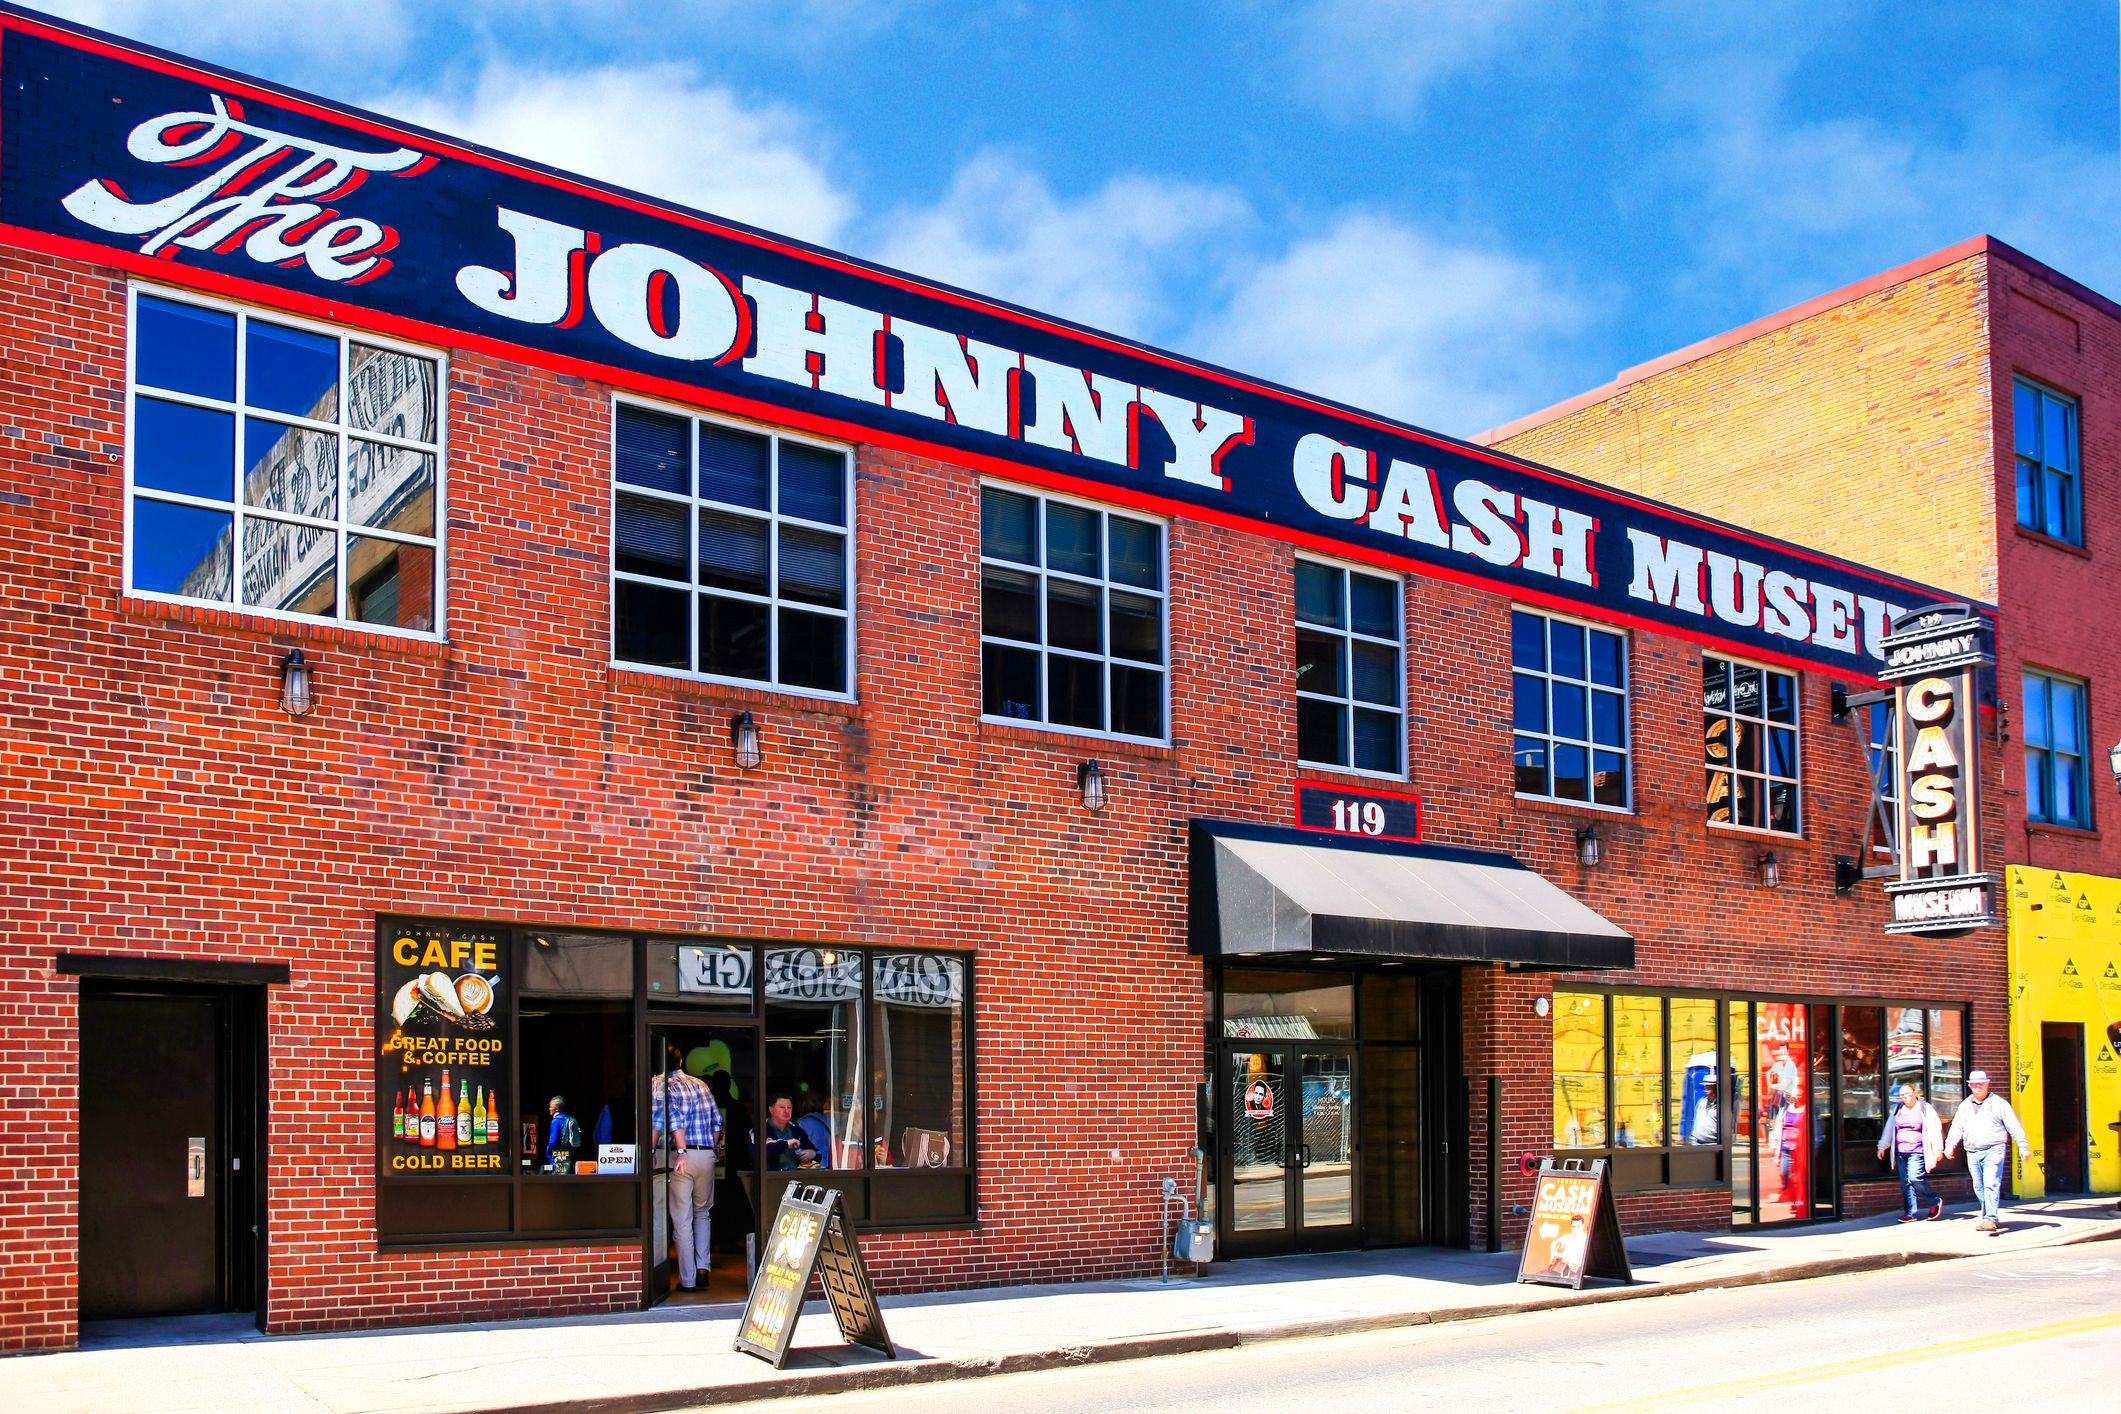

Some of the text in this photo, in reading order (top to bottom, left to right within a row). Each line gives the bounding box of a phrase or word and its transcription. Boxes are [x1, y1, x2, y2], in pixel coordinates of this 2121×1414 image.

[61, 94, 1911, 662] The JOHNNY CASH MUSEU
[1888, 634, 1974, 666] JOHNNY
[1906, 677, 1958, 867] CASH
[1332, 800, 1385, 836] 119
[1895, 887, 1983, 921] MUSEUM
[397, 930, 495, 941] JOHNNY CASH
[393, 938, 497, 970] CAFE
[1757, 1016, 1804, 1041] CASH
[390, 1036, 502, 1052] GREAT FOOD
[403, 1050, 490, 1065] & COFFEE
[392, 1155, 501, 1169] COLD BEER
[600, 1156, 633, 1164] OPEN
[1538, 1200, 1590, 1214] MUSEUM
[1541, 1183, 1594, 1208] CASH
[779, 1214, 818, 1243] CAFE
